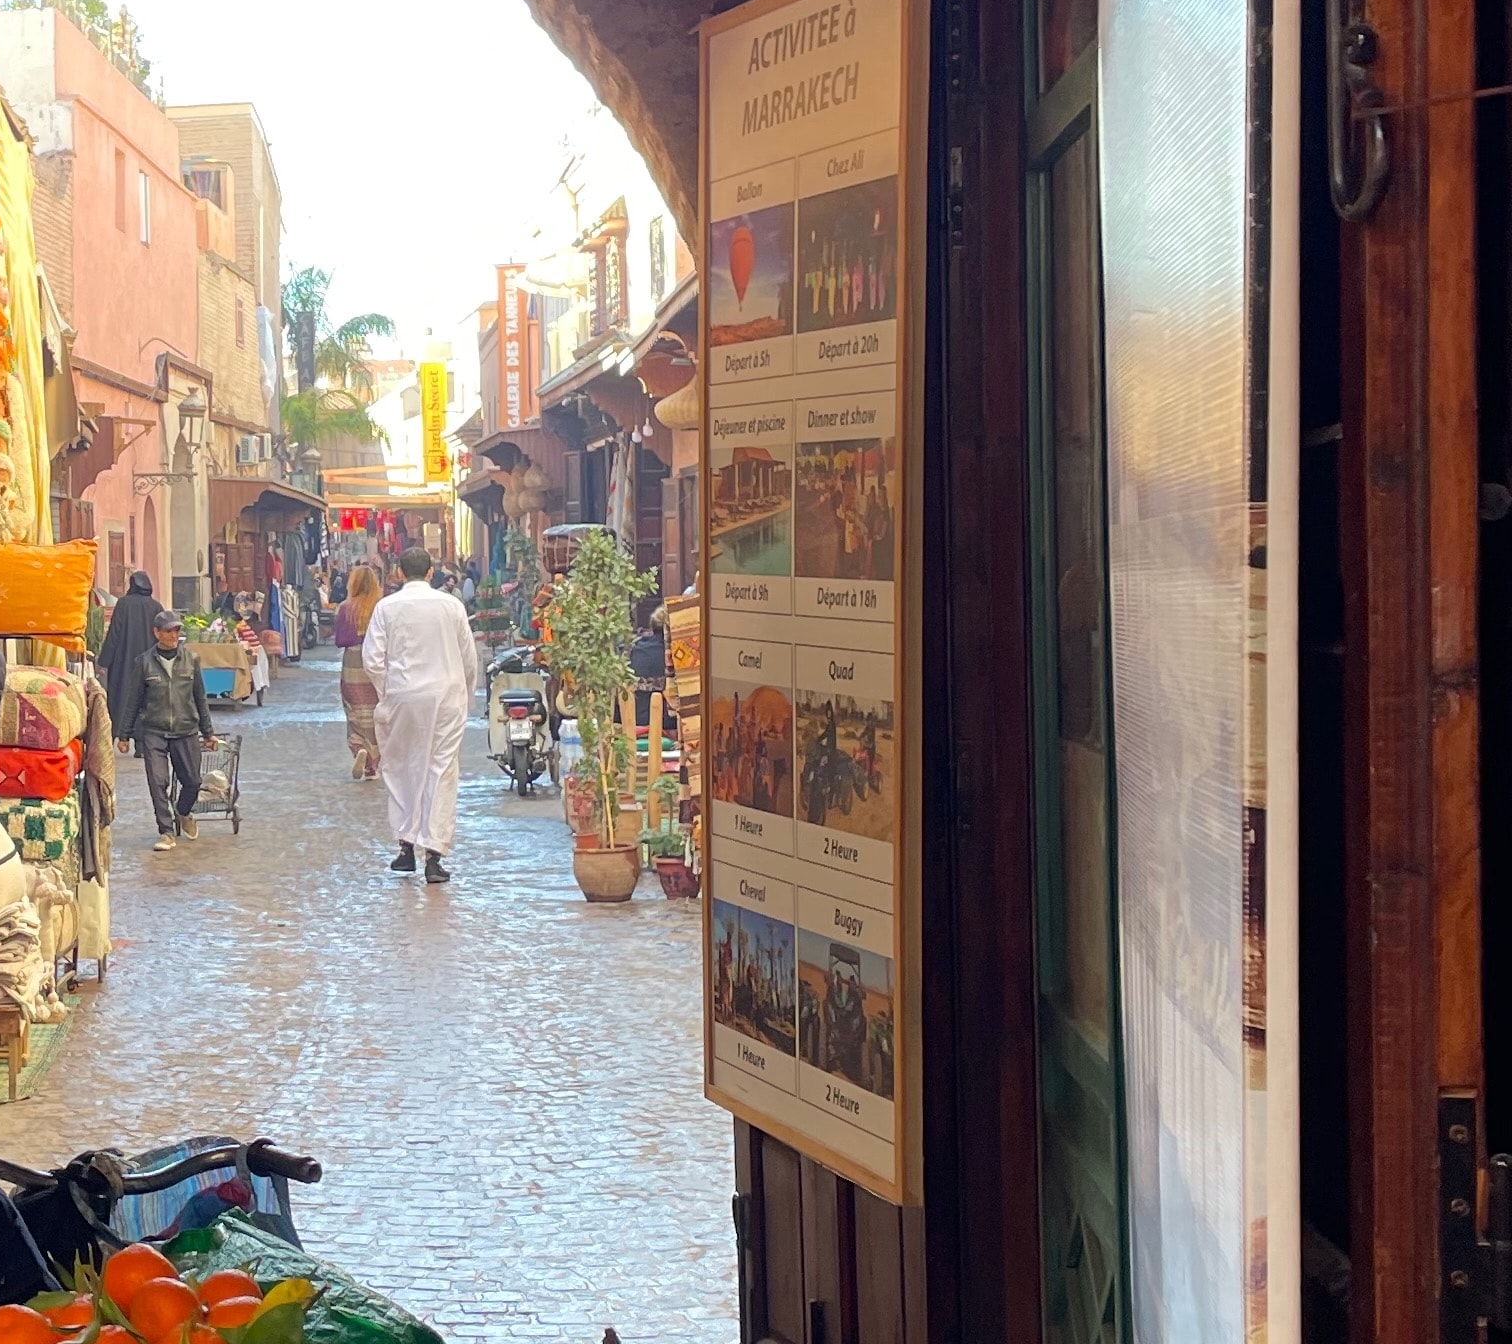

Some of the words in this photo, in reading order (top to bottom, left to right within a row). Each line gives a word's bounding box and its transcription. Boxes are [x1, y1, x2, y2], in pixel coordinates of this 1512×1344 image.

[748, 4, 841, 75] ACTIVITEE
[742, 61, 859, 136] MARRAKECH
[827, 157, 849, 177] Chez
[737, 181, 763, 203] Ballon
[506, 340, 519, 366] DES
[819, 340, 851, 363] Départ
[852, 336, 859, 355] à
[861, 333, 879, 354] 20h
[725, 354, 753, 375] Départ
[753, 350, 759, 368] à
[760, 349, 770, 367] 5h
[428, 370, 440, 411] Secret
[507, 370, 520, 429] GALERIE
[713, 418, 747, 440] Déjeuner
[748, 417, 757, 433] et
[757, 414, 786, 436] piscine
[808, 410, 838, 428] Dinner
[840, 409, 849, 426] et
[851, 405, 876, 425] show
[428, 415, 444, 454] Jardin
[725, 582, 751, 603] Départ
[752, 584, 757, 600] à
[758, 583, 769, 601] 9h
[817, 587, 849, 611] Départ
[850, 589, 857, 607] à
[860, 590, 877, 608] 18h
[738, 650, 762, 669] Camel
[829, 660, 854, 680] Quad
[740, 816, 763, 837] Heure
[823, 838, 829, 855] 2
[831, 839, 858, 862] Heure
[740, 879, 766, 902] Cheval
[834, 908, 863, 937] Buggy
[742, 1045, 765, 1070] Heure
[825, 1084, 831, 1102] 2
[833, 1087, 860, 1115] Heure
